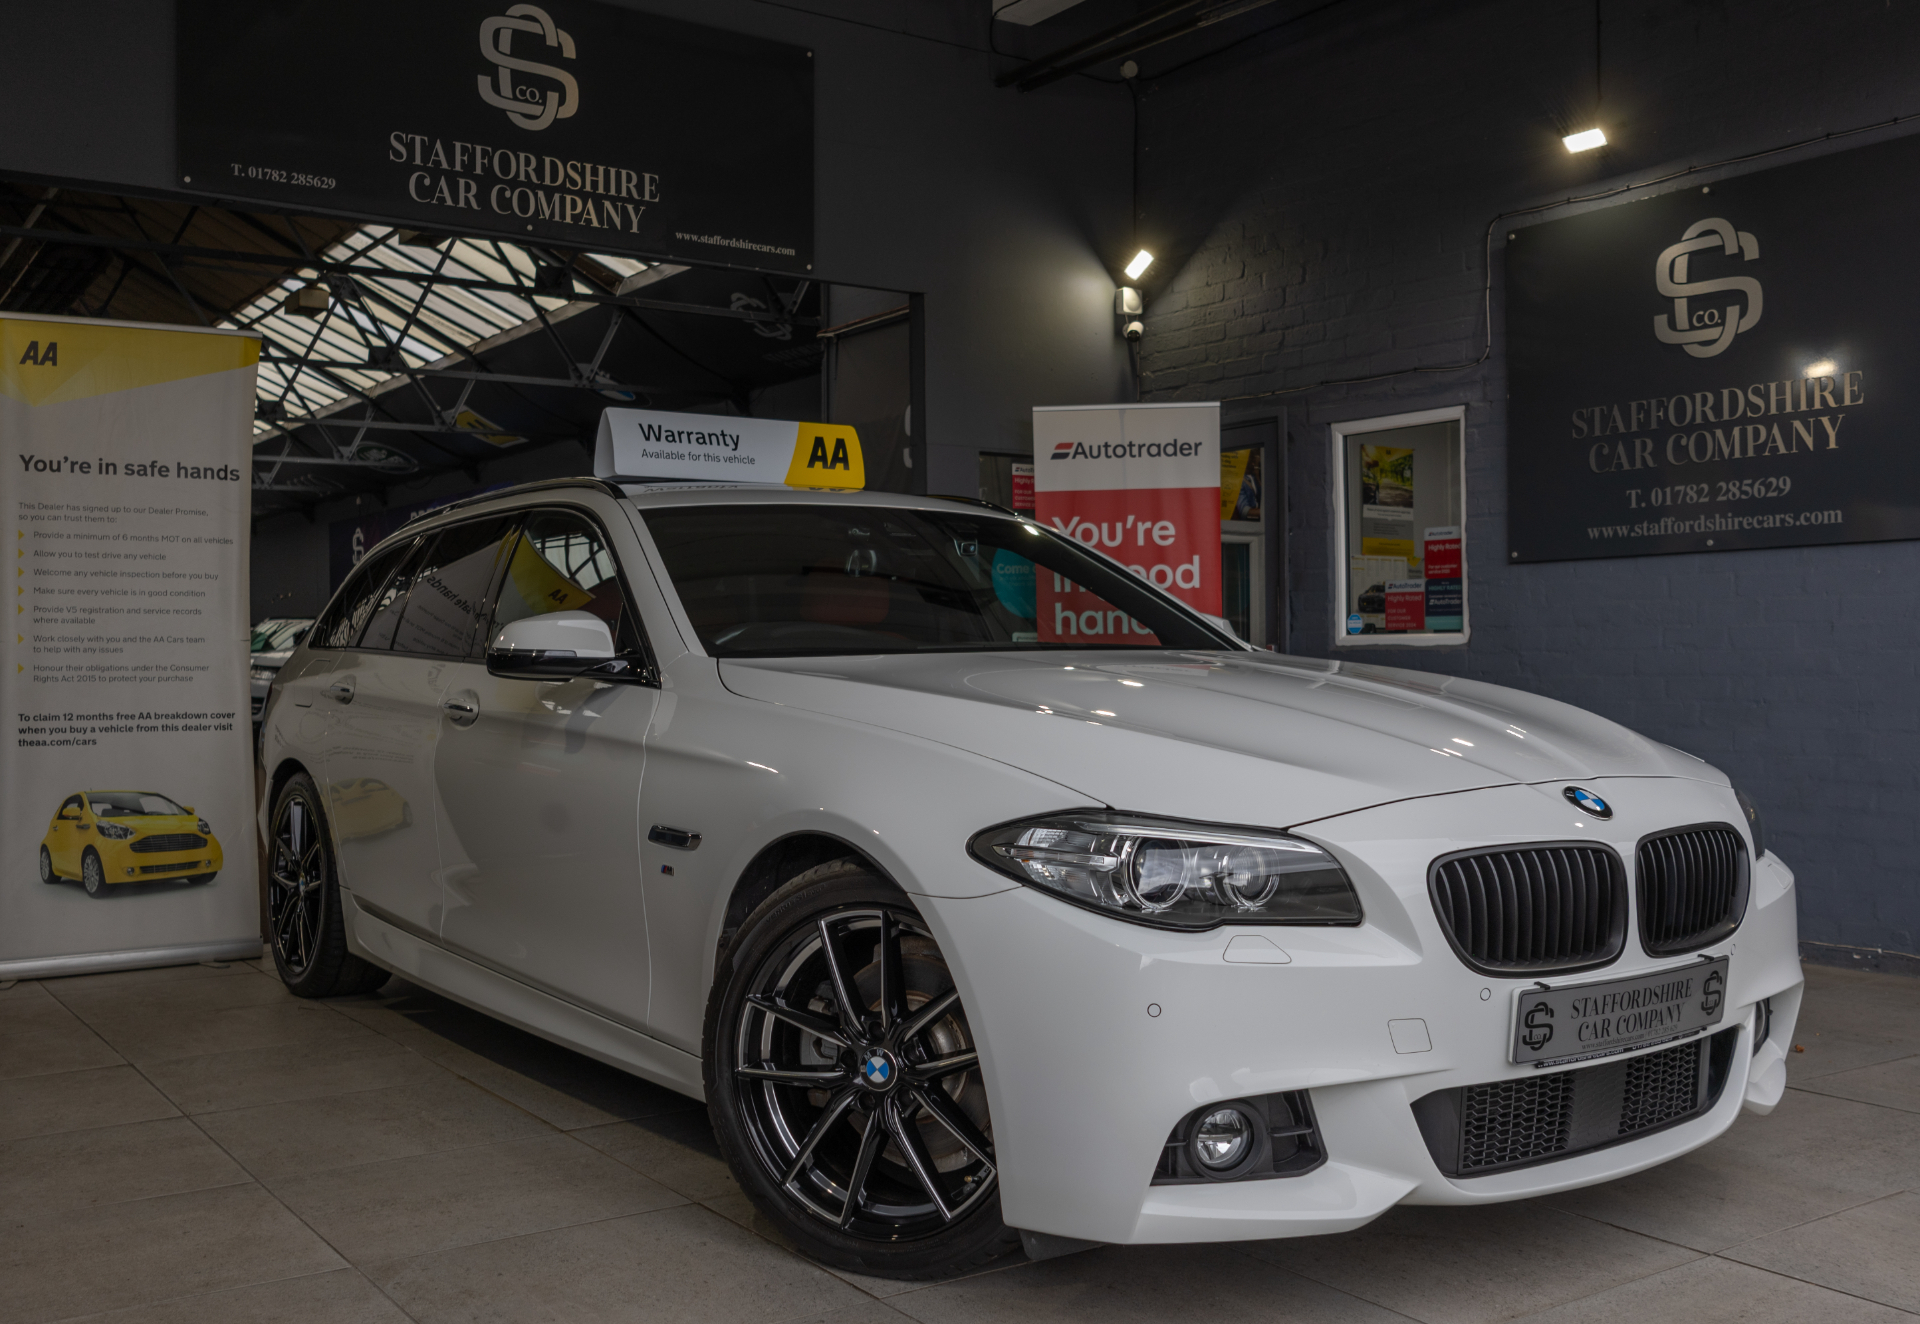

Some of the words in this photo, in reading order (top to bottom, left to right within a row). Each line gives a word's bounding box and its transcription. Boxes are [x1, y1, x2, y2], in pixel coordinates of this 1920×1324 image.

[516, 86, 542, 103] CO.
[389, 131, 660, 202] STAFFORDSHIRE
[231, 163, 245, 176] T.
[248, 166, 287, 182] 01782
[291, 172, 336, 189] 285629
[409, 172, 481, 210] CAR
[490, 184, 646, 233] COMPANY
[675, 232, 795, 256] www.staffordshirecars.com
[1692, 308, 1721, 327] CO.
[20, 341, 58, 366] AA
[1572, 370, 1864, 439] STAFFORDSHIRE
[638, 423, 740, 451] Warranty
[1589, 438, 1657, 473] CAR
[1666, 414, 1846, 466] COMPANY
[642, 449, 686, 461] Available
[688, 452, 701, 462] for
[703, 452, 720, 462] this
[722, 454, 756, 465] vehicle
[807, 436, 850, 470] AA
[1072, 439, 1202, 459] Autotrader
[98, 458, 117, 476] in
[124, 460, 170, 478] safe
[176, 461, 240, 482] hands
[1626, 490, 1646, 508] T.
[1651, 483, 1710, 507] 01782
[1716, 476, 1792, 502] 285629
[64, 514, 82, 522] trust
[84, 514, 104, 523] them
[82, 504, 108, 514] signed
[111, 506, 122, 514] up
[149, 507, 173, 515] Dealer
[176, 508, 209, 516] Promise,
[1587, 509, 1843, 539] www.staffordshirecars.com
[204, 536, 233, 545] vehicles
[58, 552, 72, 560] you
[102, 551, 122, 559] drive
[34, 568, 71, 576] Welcome
[74, 570, 88, 578] any
[120, 570, 160, 580] inspection
[162, 571, 186, 579] before
[189, 573, 202, 581] you
[205, 572, 218, 581] buy
[148, 589, 167, 597] good
[170, 589, 205, 597] condition
[79, 607, 124, 615] registration
[58, 635, 85, 644] closely
[43, 646, 61, 655] help
[82, 647, 96, 655] any
[85, 664, 129, 674] obligations
[33, 675, 59, 684] Rights
[108, 675, 137, 684] protect
[157, 675, 193, 684] purchase
[33, 714, 60, 722] claim
[76, 713, 113, 721] months
[116, 712, 136, 720] free
[138, 712, 152, 720] AA
[154, 712, 208, 720] breakdown
[18, 726, 46, 734] when
[48, 727, 67, 736] you
[70, 725, 87, 735] buy
[98, 725, 134, 733] vehicle
[136, 724, 159, 732] from
[161, 724, 179, 732] this
[181, 723, 212, 732] dealer
[214, 722, 232, 731] visit
[18, 738, 97, 747] theaa.com/cars
[1571, 978, 1693, 1019] STAFFORDSHIRE
[1578, 1019, 1611, 1042] CAR
[1616, 1002, 1685, 1036] COMPANY
